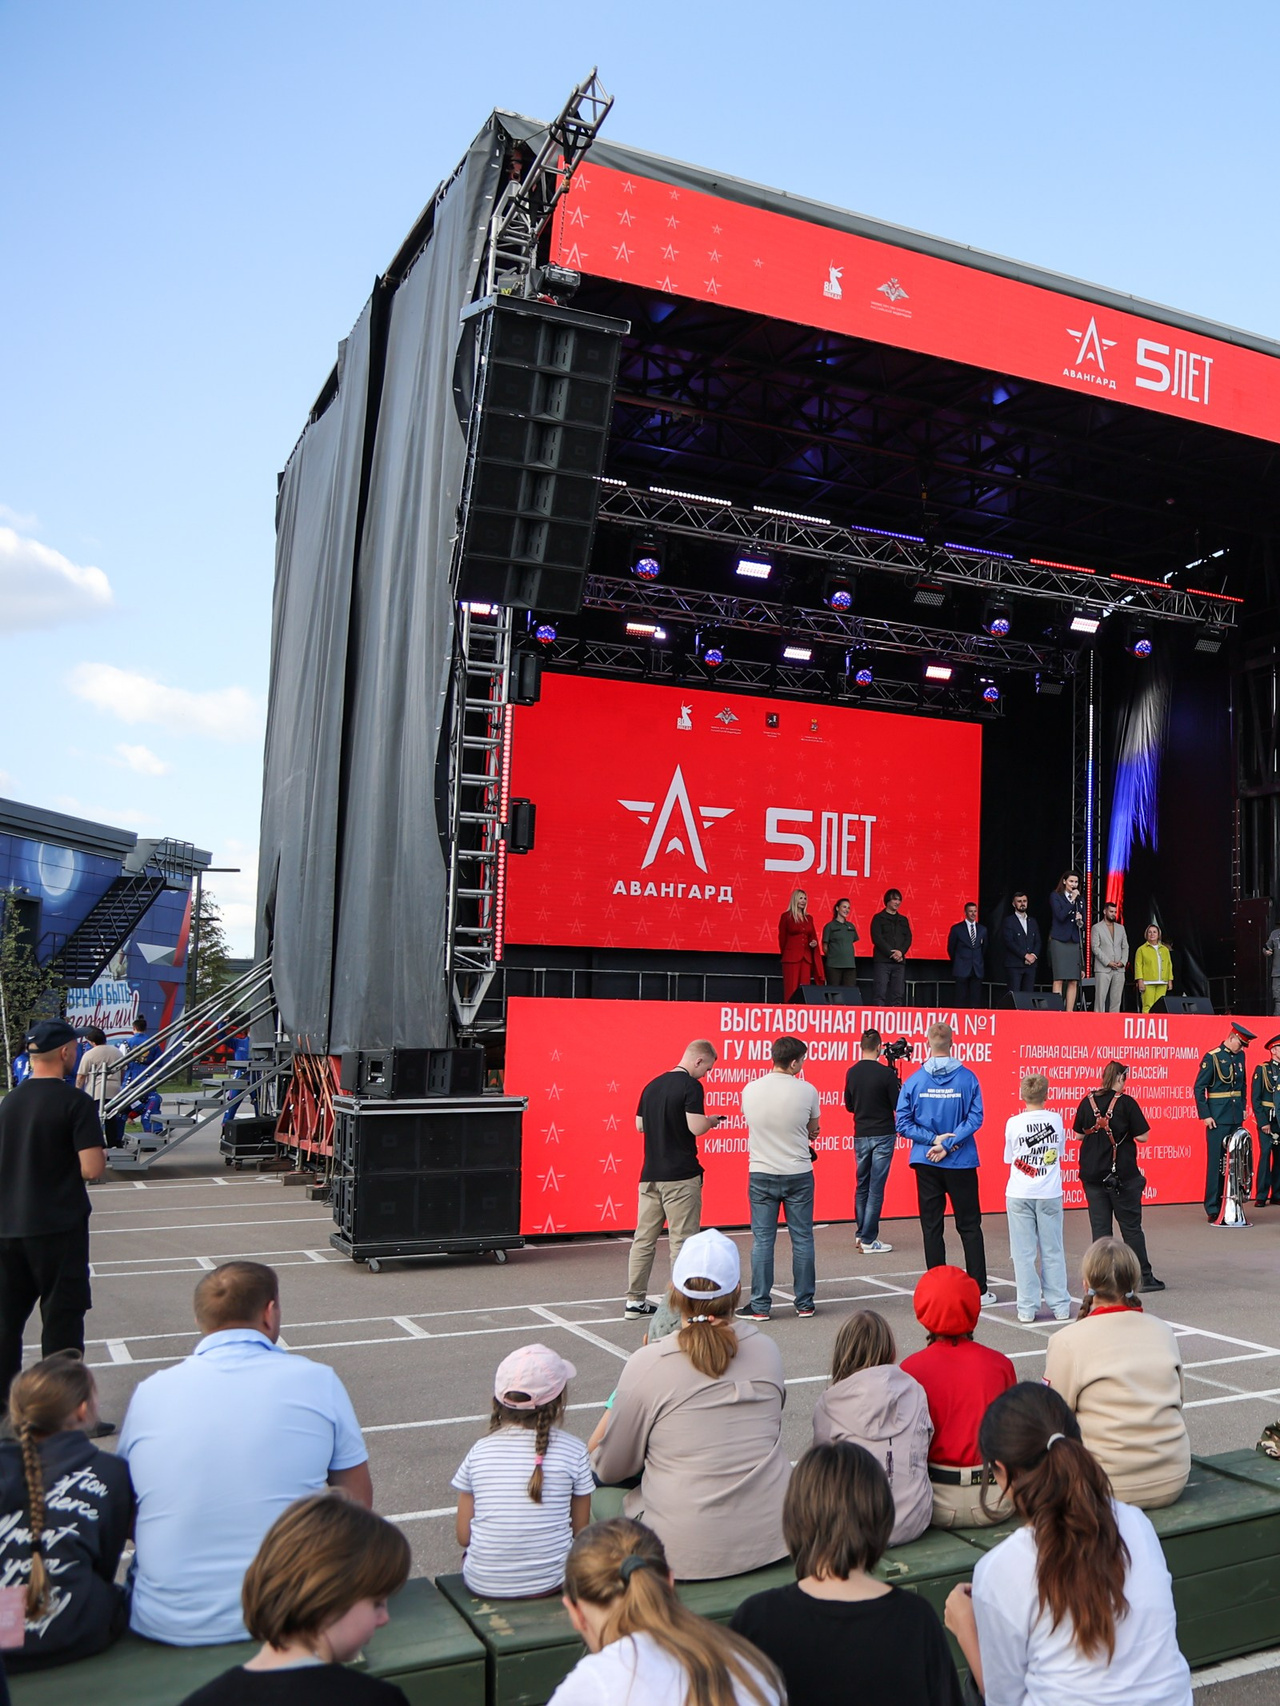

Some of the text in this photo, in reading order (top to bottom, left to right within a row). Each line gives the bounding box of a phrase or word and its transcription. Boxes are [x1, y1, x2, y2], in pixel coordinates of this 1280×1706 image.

[1062, 368, 1117, 390] АВАНГАРД
[612, 880, 734, 903] АВАНГАРД
[720, 1007, 856, 1034] ВЫСТАВОЧНАЯ
[1124, 1017, 1169, 1042] ПЛАЦ
[724, 1040, 745, 1060] ГУ
[748, 1040, 772, 1061] МВ
[950, 1042, 993, 1063] ОСКВЕ
[1020, 1045, 1060, 1059] ГЛАВНАЯ
[1061, 1045, 1089, 1059] СЦЕНА
[1097, 1046, 1150, 1060] КОНЦЕРТНАЯ
[1151, 1046, 1200, 1060] ПРОГРАММА
[1132, 1064, 1168, 1079] БАССЕЙН
[1143, 1086, 1184, 1100] ПАМЯТНОЕ
